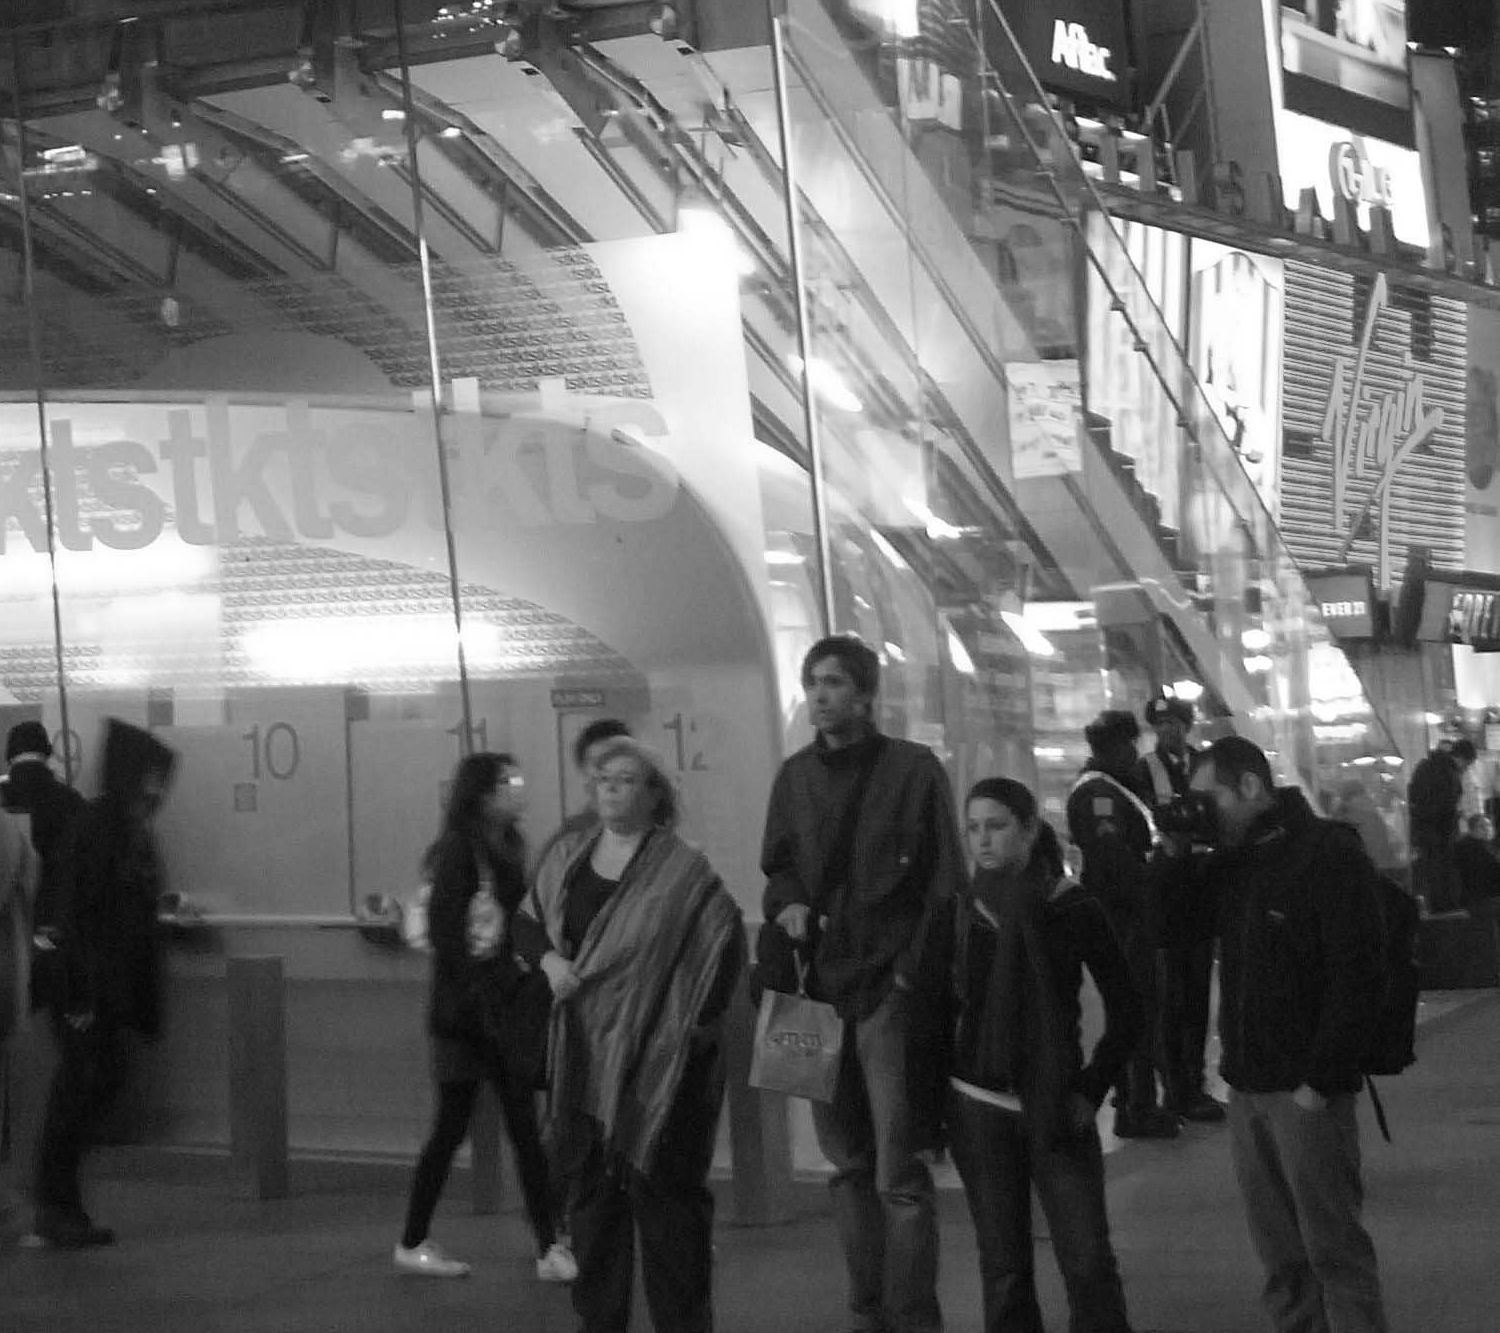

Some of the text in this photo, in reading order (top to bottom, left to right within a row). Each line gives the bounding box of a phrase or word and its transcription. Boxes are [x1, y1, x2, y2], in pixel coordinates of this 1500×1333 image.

[158, 395, 407, 548] tkts
[1319, 272, 1445, 591] Virgin
[242, 721, 299, 781] 10
